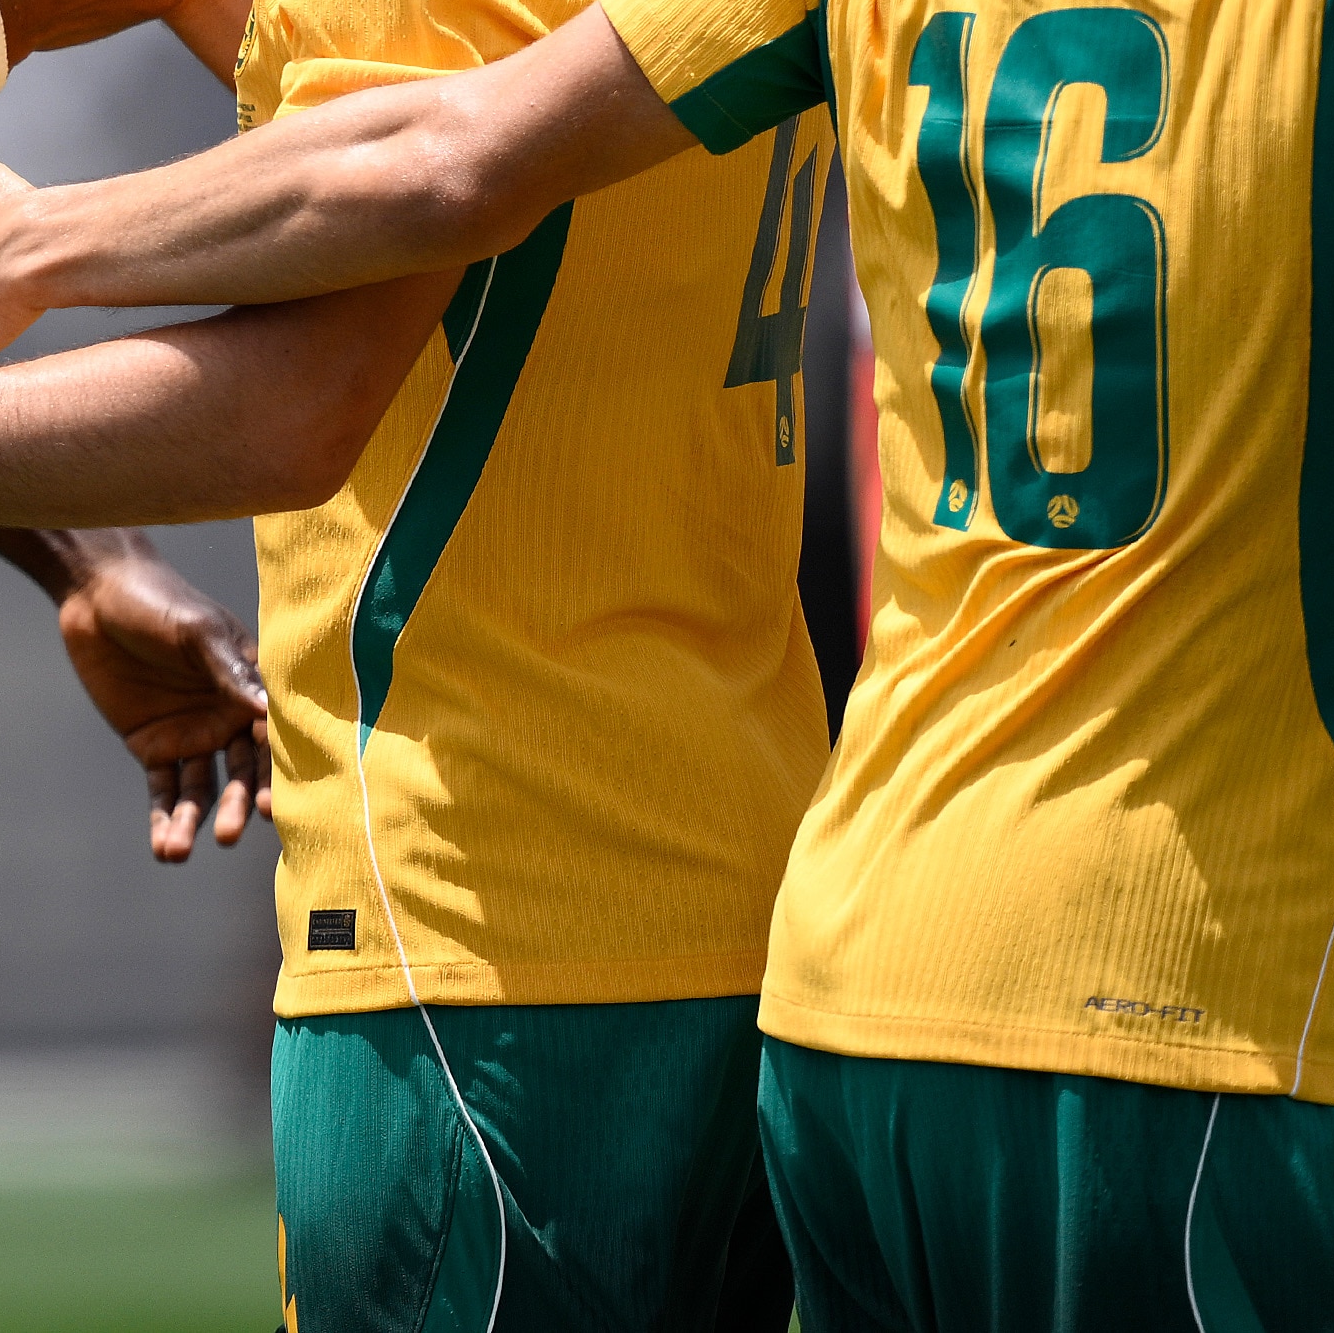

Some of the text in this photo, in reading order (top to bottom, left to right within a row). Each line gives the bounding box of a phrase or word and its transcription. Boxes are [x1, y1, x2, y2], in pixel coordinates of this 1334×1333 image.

[723, 113, 818, 467] 4
[907, 6, 1171, 550] 16
[1084, 996, 1206, 1023] AERO-FIT
